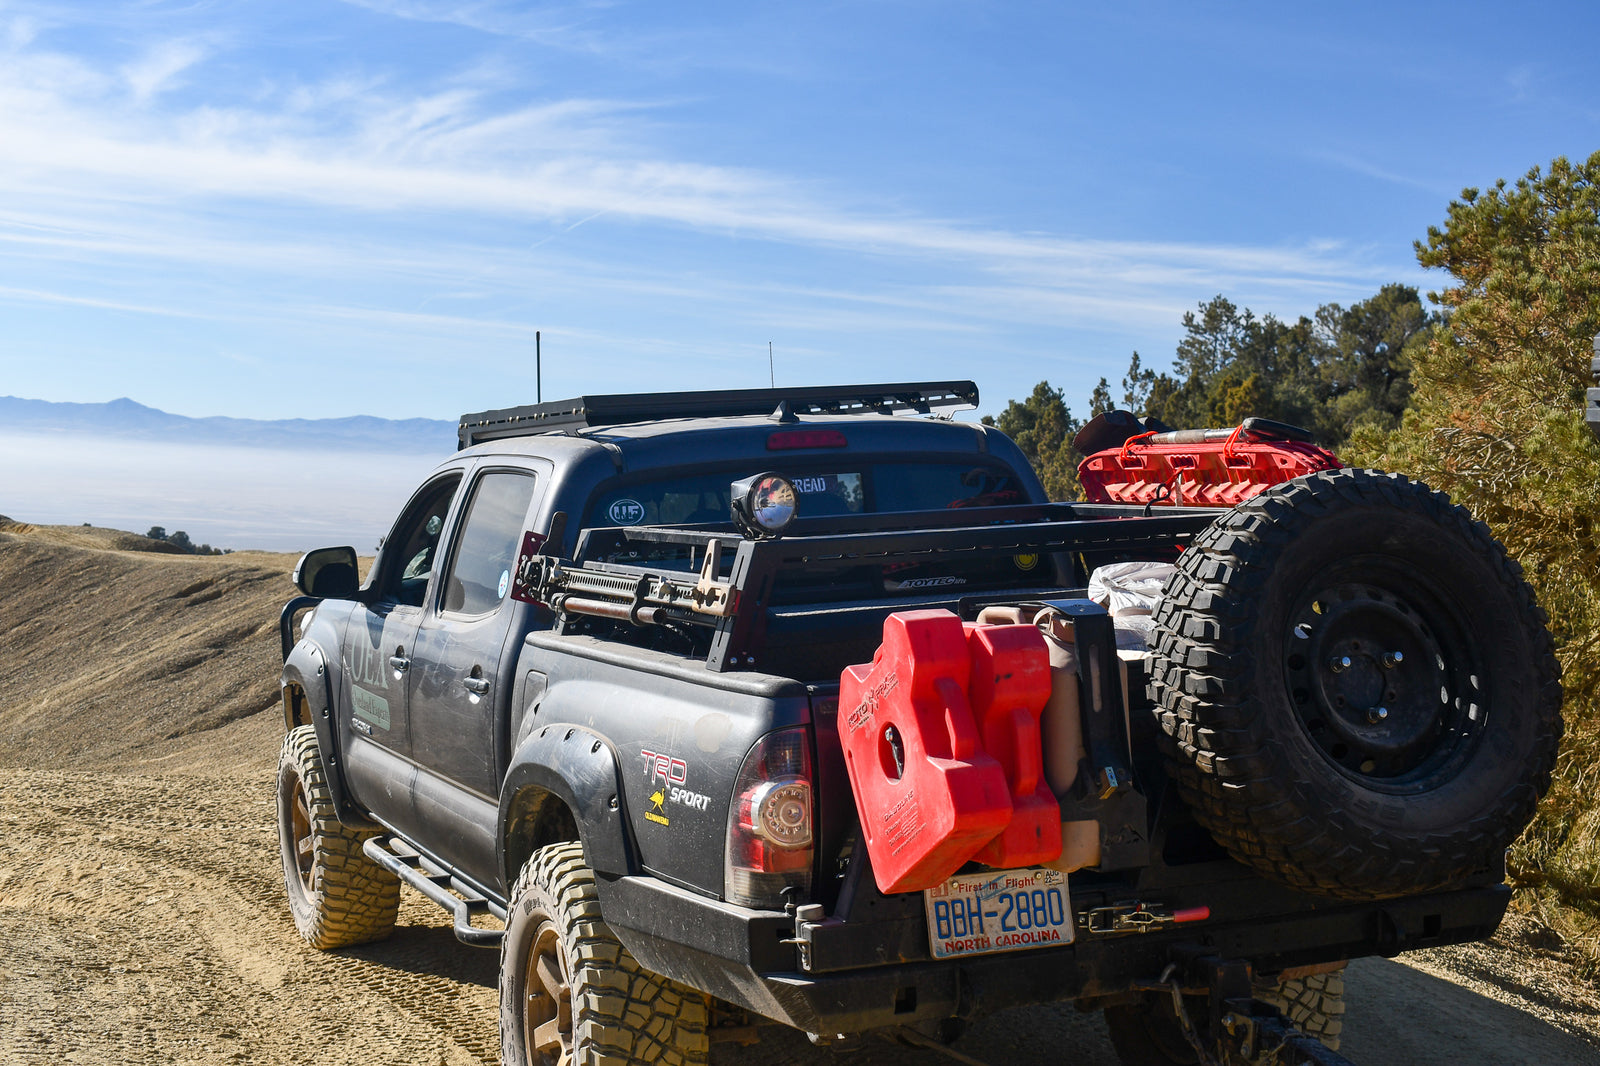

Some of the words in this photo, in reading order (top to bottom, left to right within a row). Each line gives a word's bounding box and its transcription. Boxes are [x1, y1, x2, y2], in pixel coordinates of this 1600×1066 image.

[641, 749, 687, 789] TRD
[669, 787, 711, 811] SPORT
[958, 882, 983, 893] First
[1005, 876, 1035, 889] Flight
[934, 889, 1064, 940] BBH-2880
[944, 936, 992, 953] NORTH
[995, 928, 1061, 947] CAROLINA
